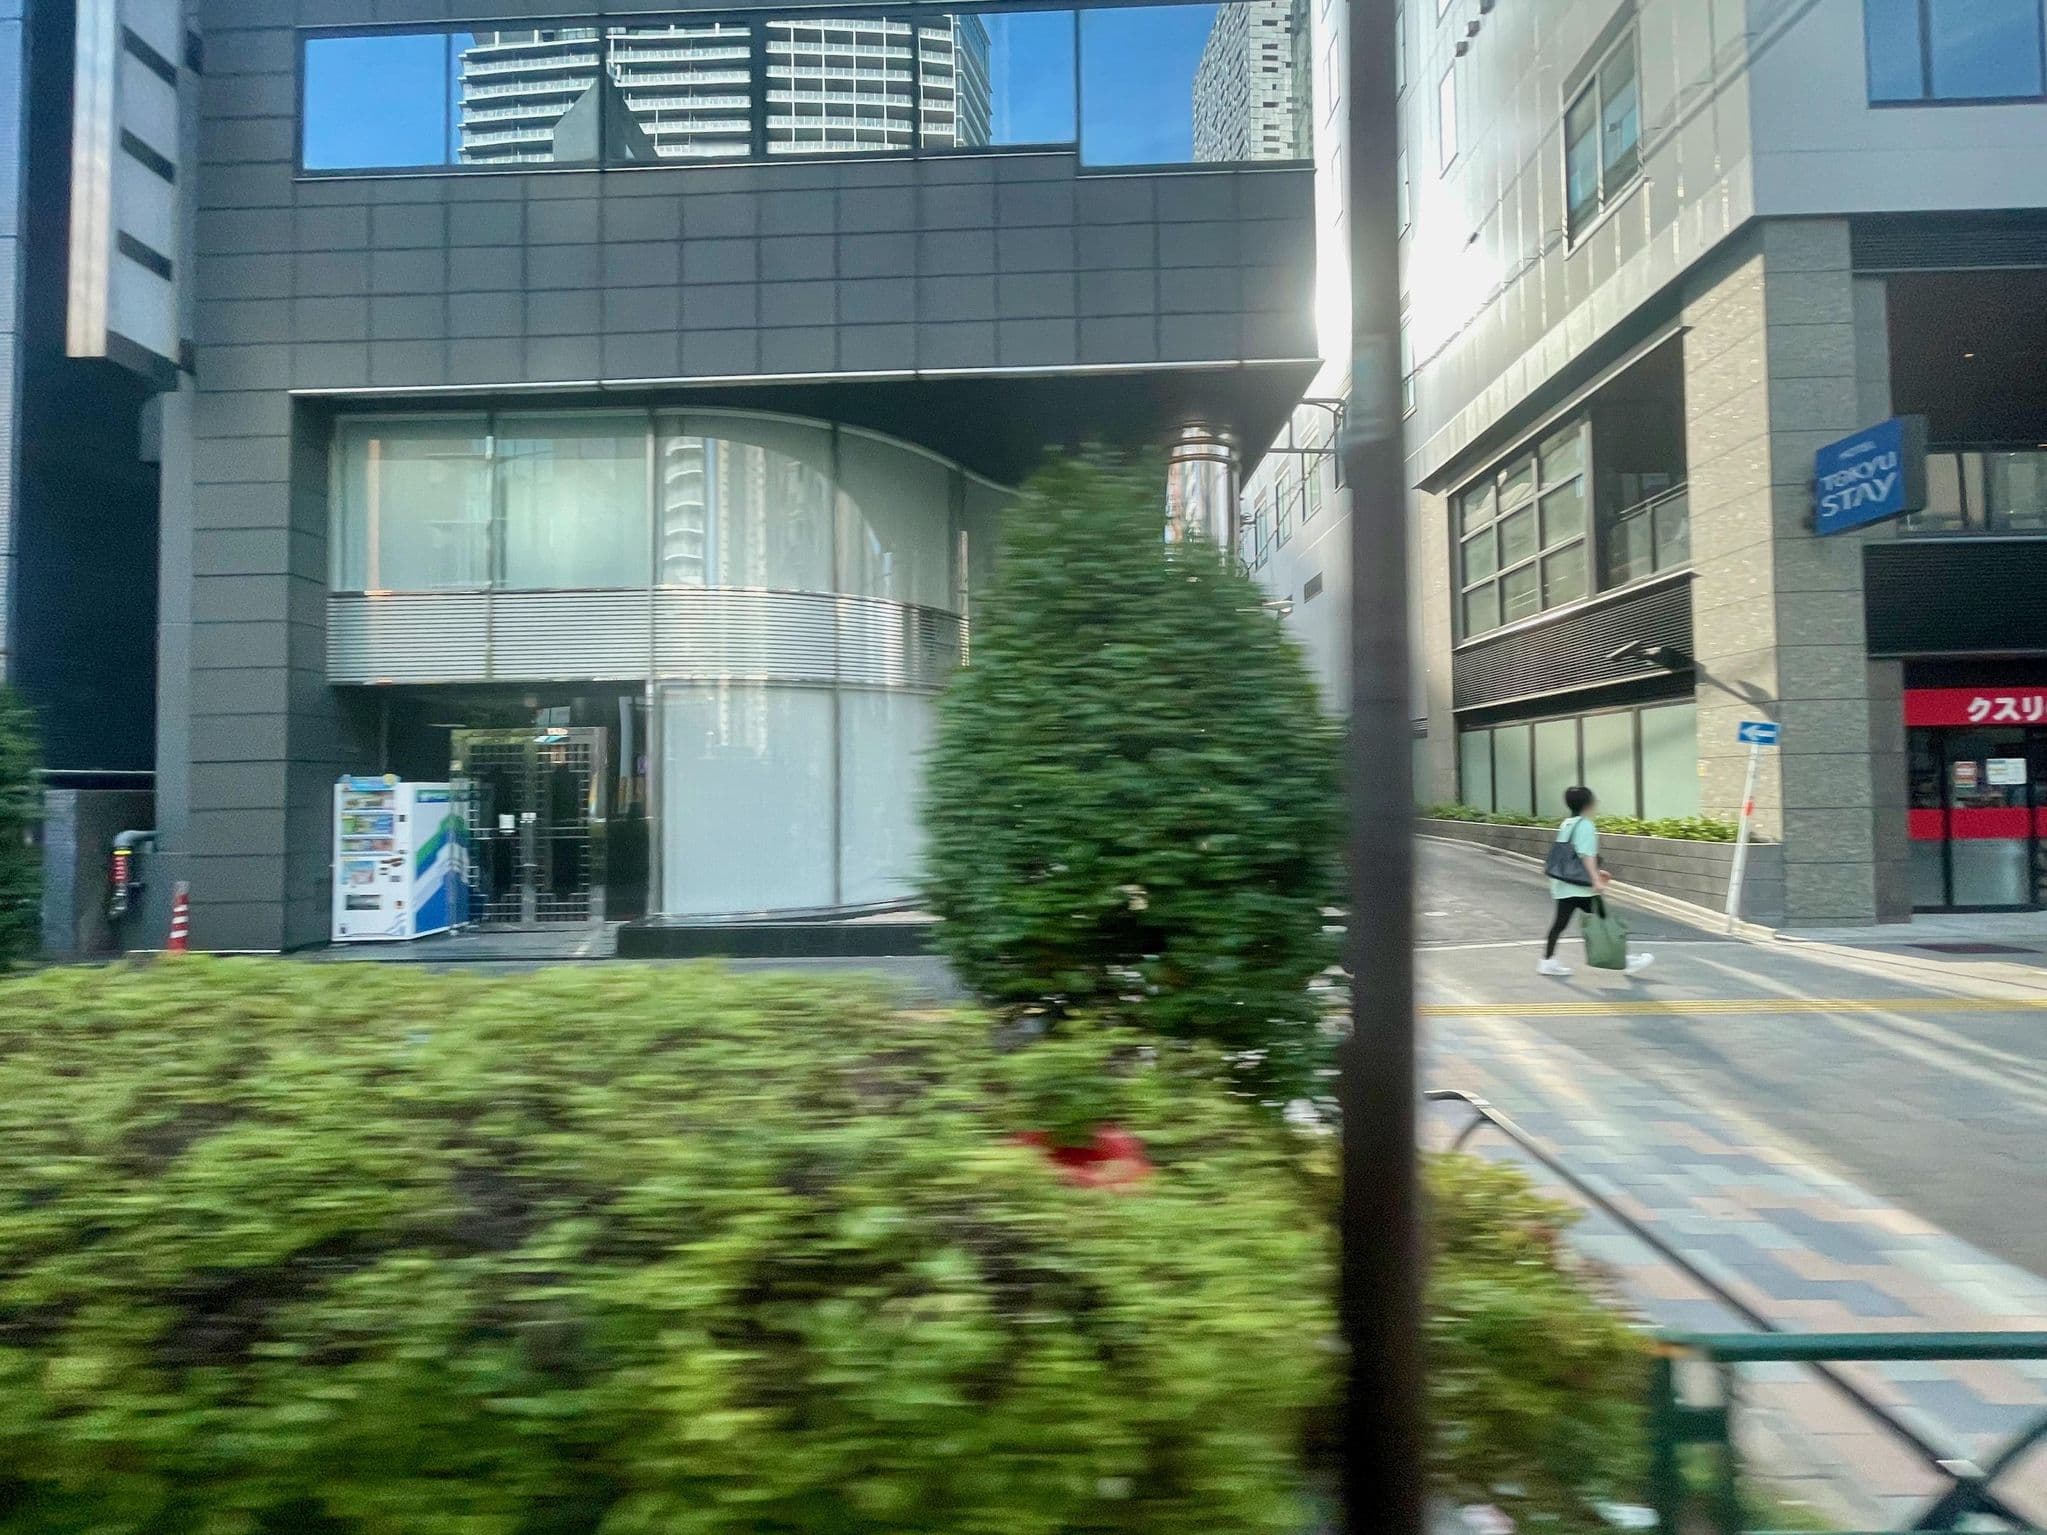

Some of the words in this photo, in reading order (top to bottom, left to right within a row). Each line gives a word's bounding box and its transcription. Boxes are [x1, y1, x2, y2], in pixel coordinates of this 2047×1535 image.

[1820, 451, 1897, 490] TOKYU
[1821, 472, 1896, 516] STAY
[1967, 696, 2047, 722] クスリ
